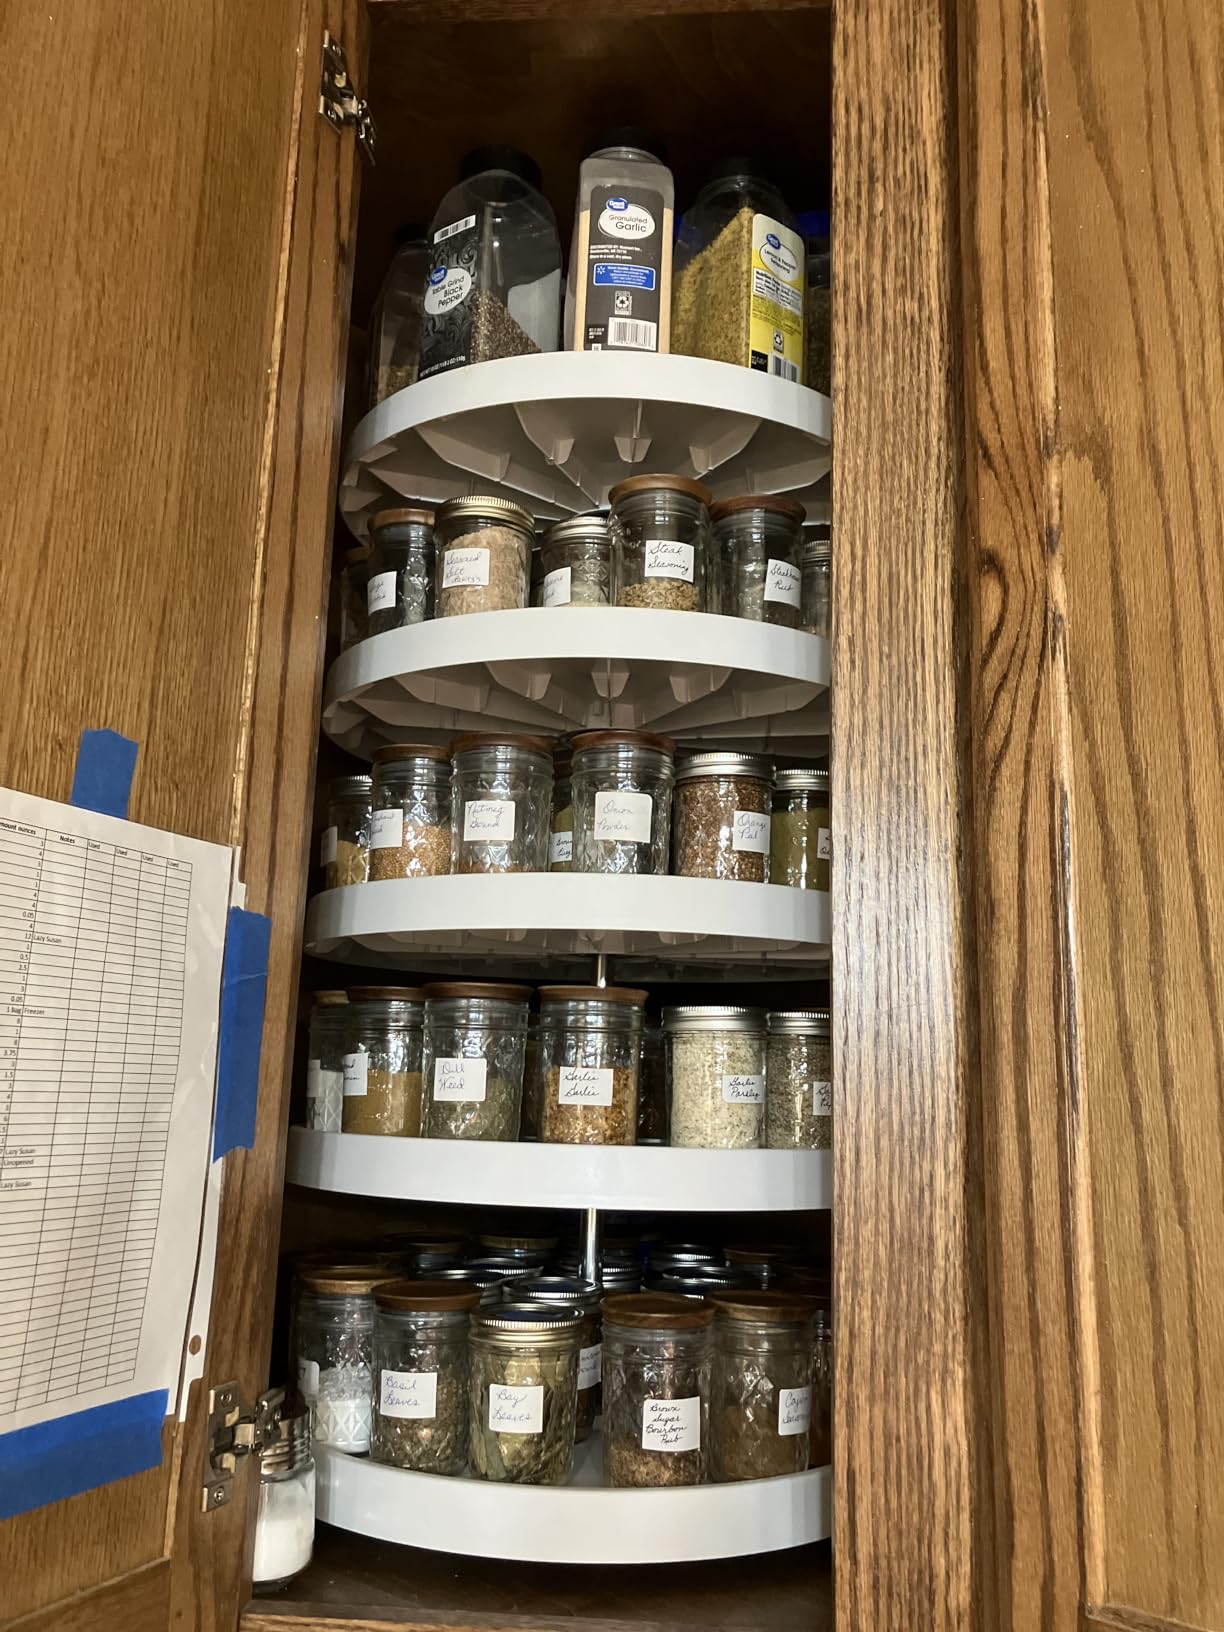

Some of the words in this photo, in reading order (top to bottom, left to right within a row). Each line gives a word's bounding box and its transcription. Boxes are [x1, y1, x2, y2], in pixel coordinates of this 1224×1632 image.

[608, 214, 648, 224] Granulated
[615, 221, 648, 233] Garlic
[432, 284, 447, 295] Table
[447, 275, 465, 288] Grind
[443, 284, 464, 298] Black
[437, 292, 464, 309] Pepper
[648, 541, 683, 555] Steak
[774, 580, 794, 591] Rub
[467, 801, 505, 818] Nutmeg
[603, 799, 633, 814] Onion
[0, 822, 17, 830] mount
[18, 826, 36, 835] ounces
[60, 835, 76, 844] Notes
[88, 841, 101, 850] Used
[116, 848, 128, 856] Used
[143, 854, 154, 862] Used
[168, 860, 180, 868] Used
[33, 933, 45, 942] Lazy
[20, 953, 29, 961] 0.5
[442, 1061, 465, 1074] Dill
[438, 1076, 465, 1091] Weed
[4, 1158, 34, 1167] Unopened
[386, 1375, 417, 1390] Basil
[384, 1390, 420, 1406] Leaves
[496, 1388, 528, 1408] Bay
[492, 1406, 532, 1421] Leaves
[660, 1433, 683, 1443] Rub
